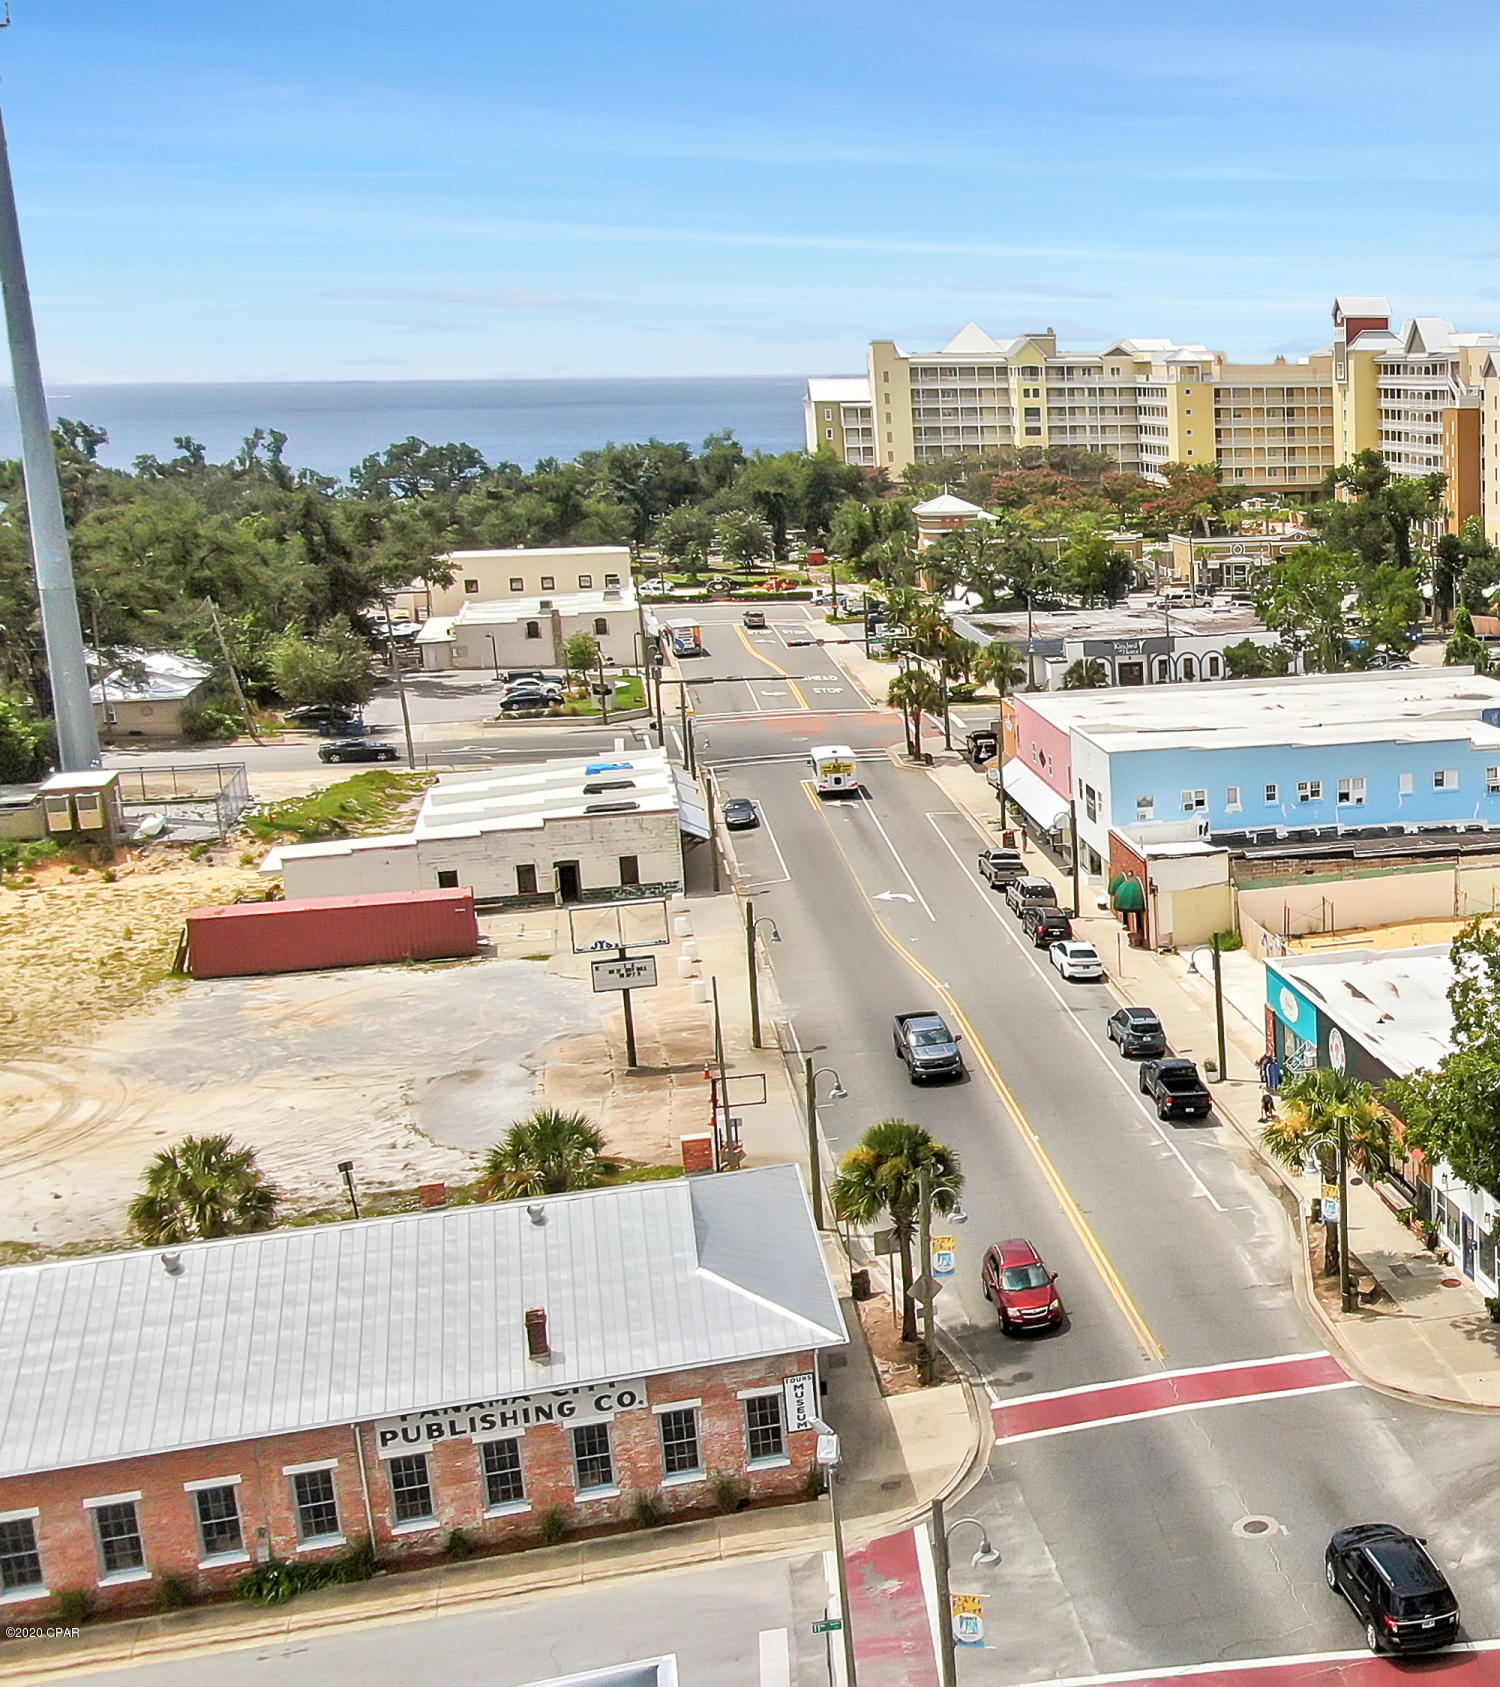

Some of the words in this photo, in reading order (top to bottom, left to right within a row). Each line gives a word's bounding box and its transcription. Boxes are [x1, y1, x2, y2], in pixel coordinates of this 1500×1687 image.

[785, 1375, 812, 1385] TOURS
[380, 1400, 576, 1447] PUBLISHING
[594, 1390, 644, 1412] CO.
[793, 1383, 808, 1429] MUSEUM
